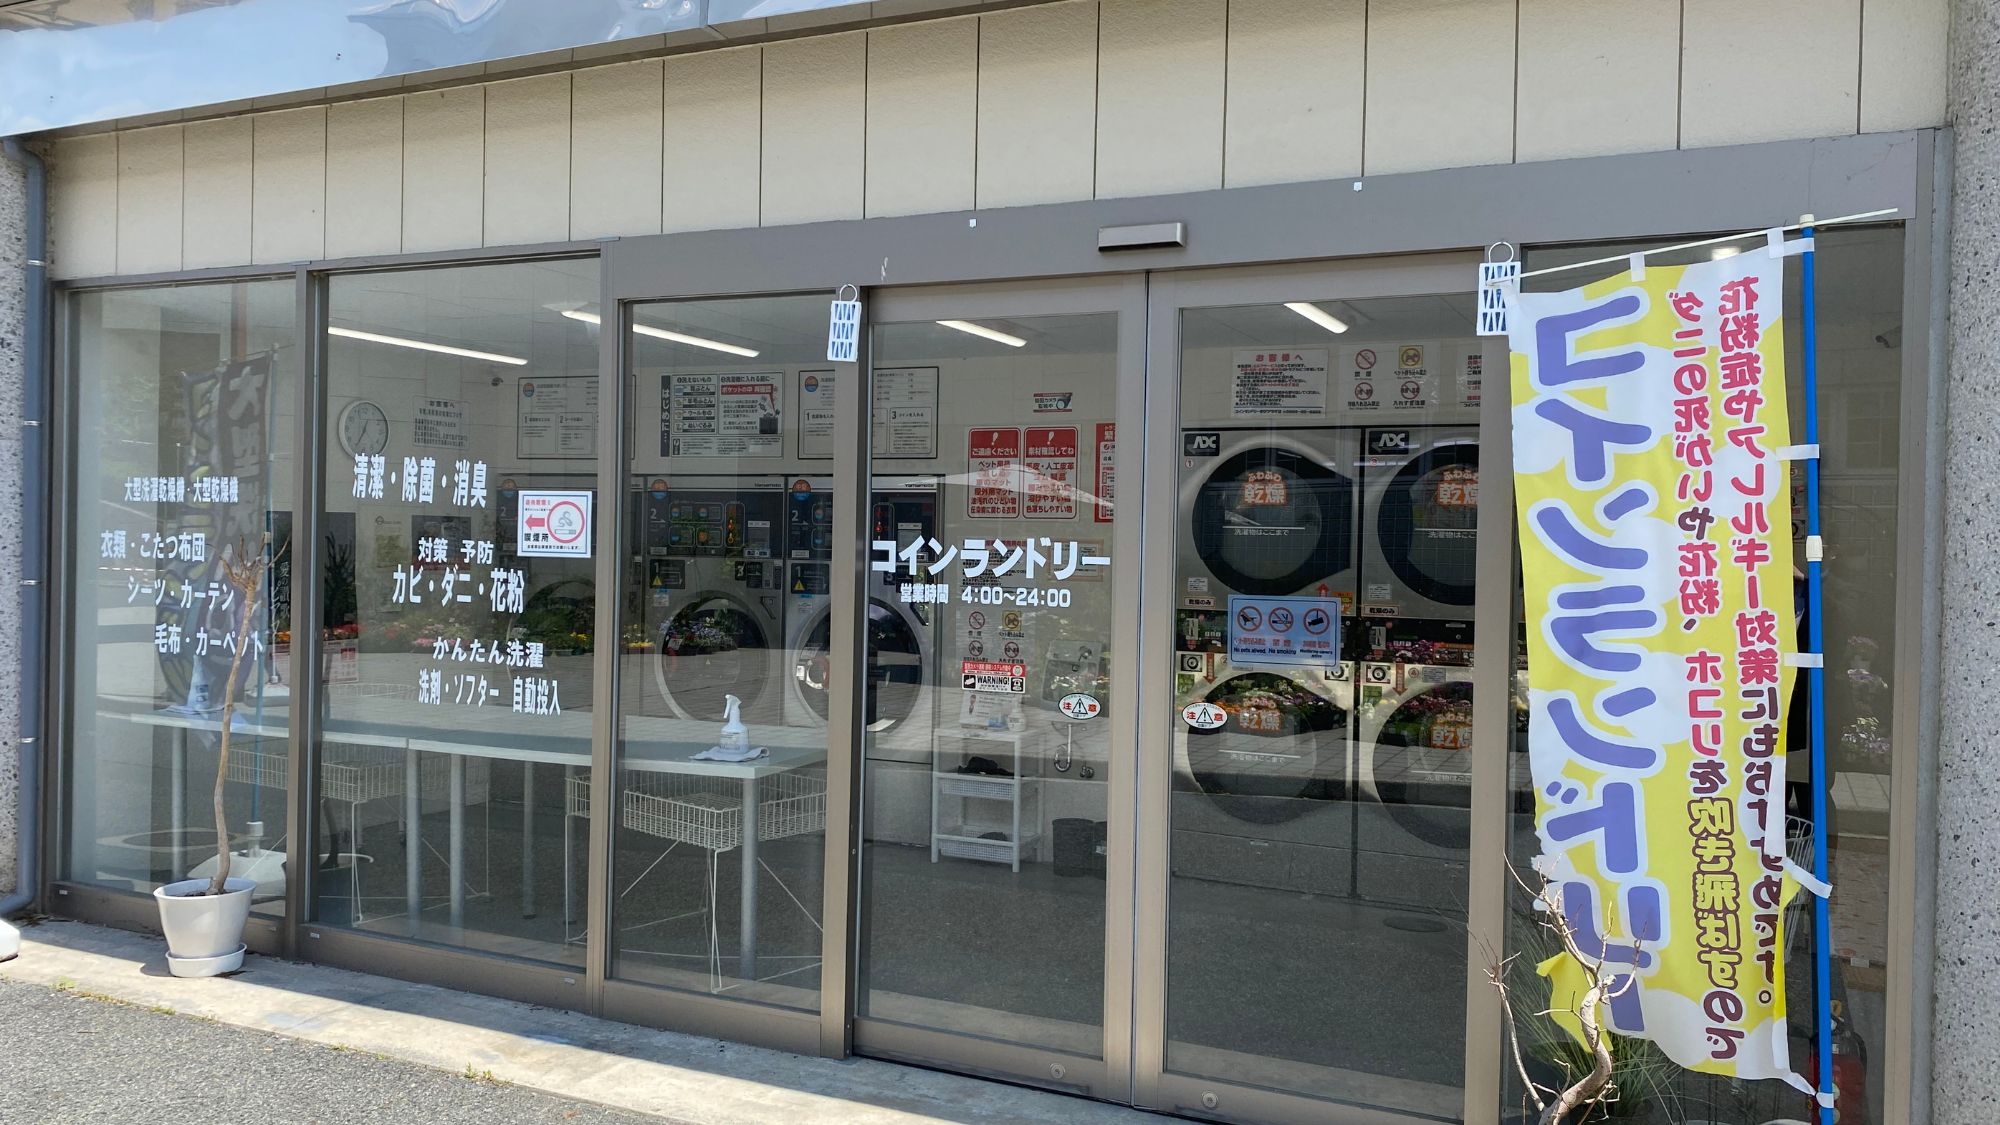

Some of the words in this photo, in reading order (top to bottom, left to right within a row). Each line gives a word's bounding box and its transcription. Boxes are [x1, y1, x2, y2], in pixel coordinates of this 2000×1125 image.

[124, 476, 239, 503] 大型洗濯乾燥機・大型乾燥機
[352, 453, 487, 509] 清潔・除菌・消臭
[100, 530, 205, 562] 衣類・こたつ布団
[418, 537, 448, 563] 対策
[460, 539, 494, 565] 予防
[871, 537, 1111, 581] コインランドリー
[128, 575, 234, 611] シーツ・カーテン
[392, 563, 525, 614] カビ・ダニ・花粉
[900, 582, 949, 604] 営業時間
[432, 636, 544, 668] かんたん洗濯
[418, 668, 499, 708] 洗剤・ソフター
[512, 676, 561, 716] 自動投入
[977, 676, 1010, 685] WARNING!
